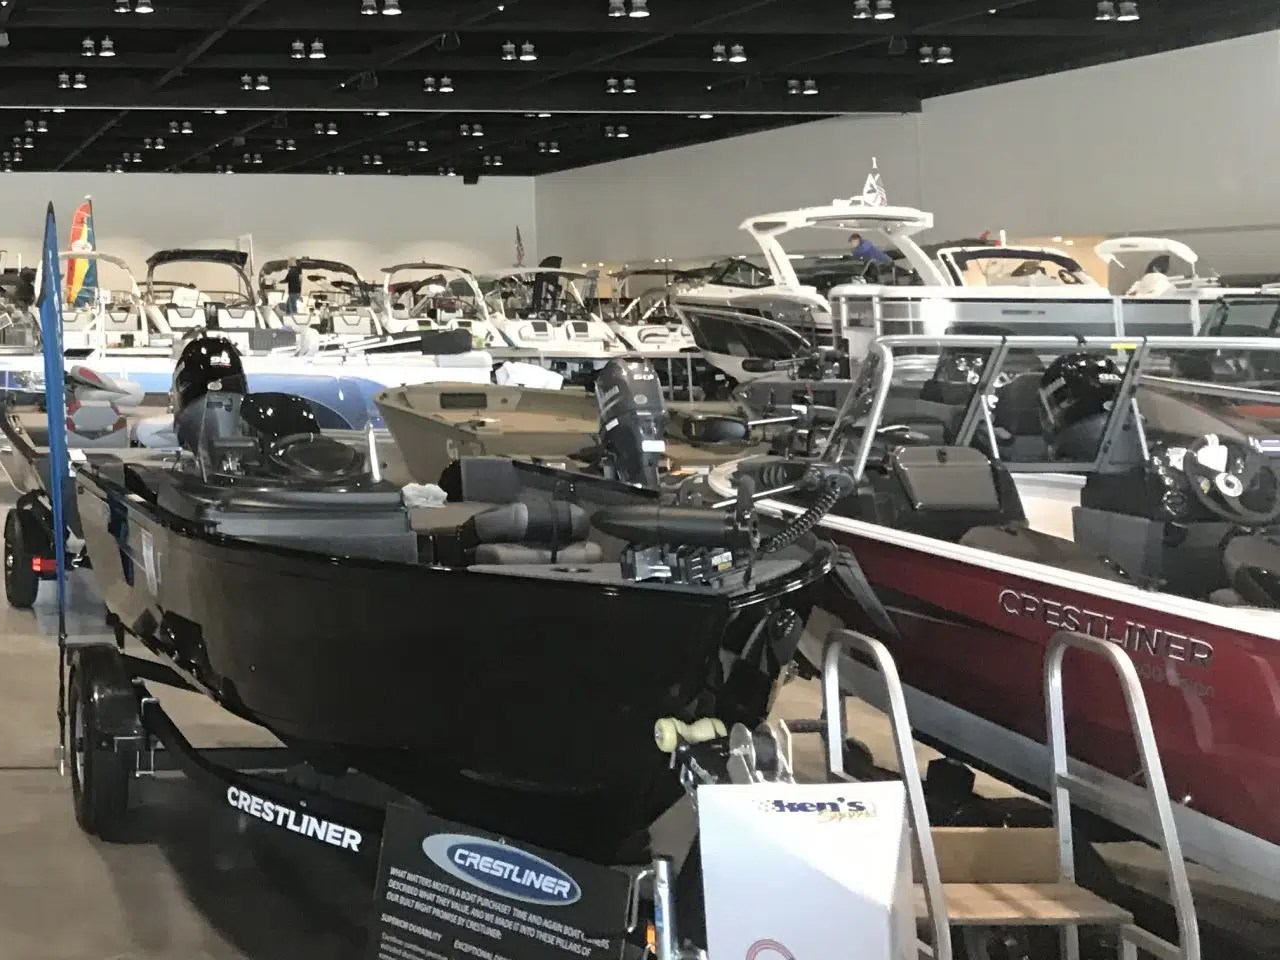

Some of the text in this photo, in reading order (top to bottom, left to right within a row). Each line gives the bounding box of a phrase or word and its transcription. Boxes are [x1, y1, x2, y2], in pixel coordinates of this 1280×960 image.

[998, 588, 1215, 667] CRESTLINER
[226, 785, 363, 853] CRESTLINER
[453, 847, 572, 900] CRESTLINER
